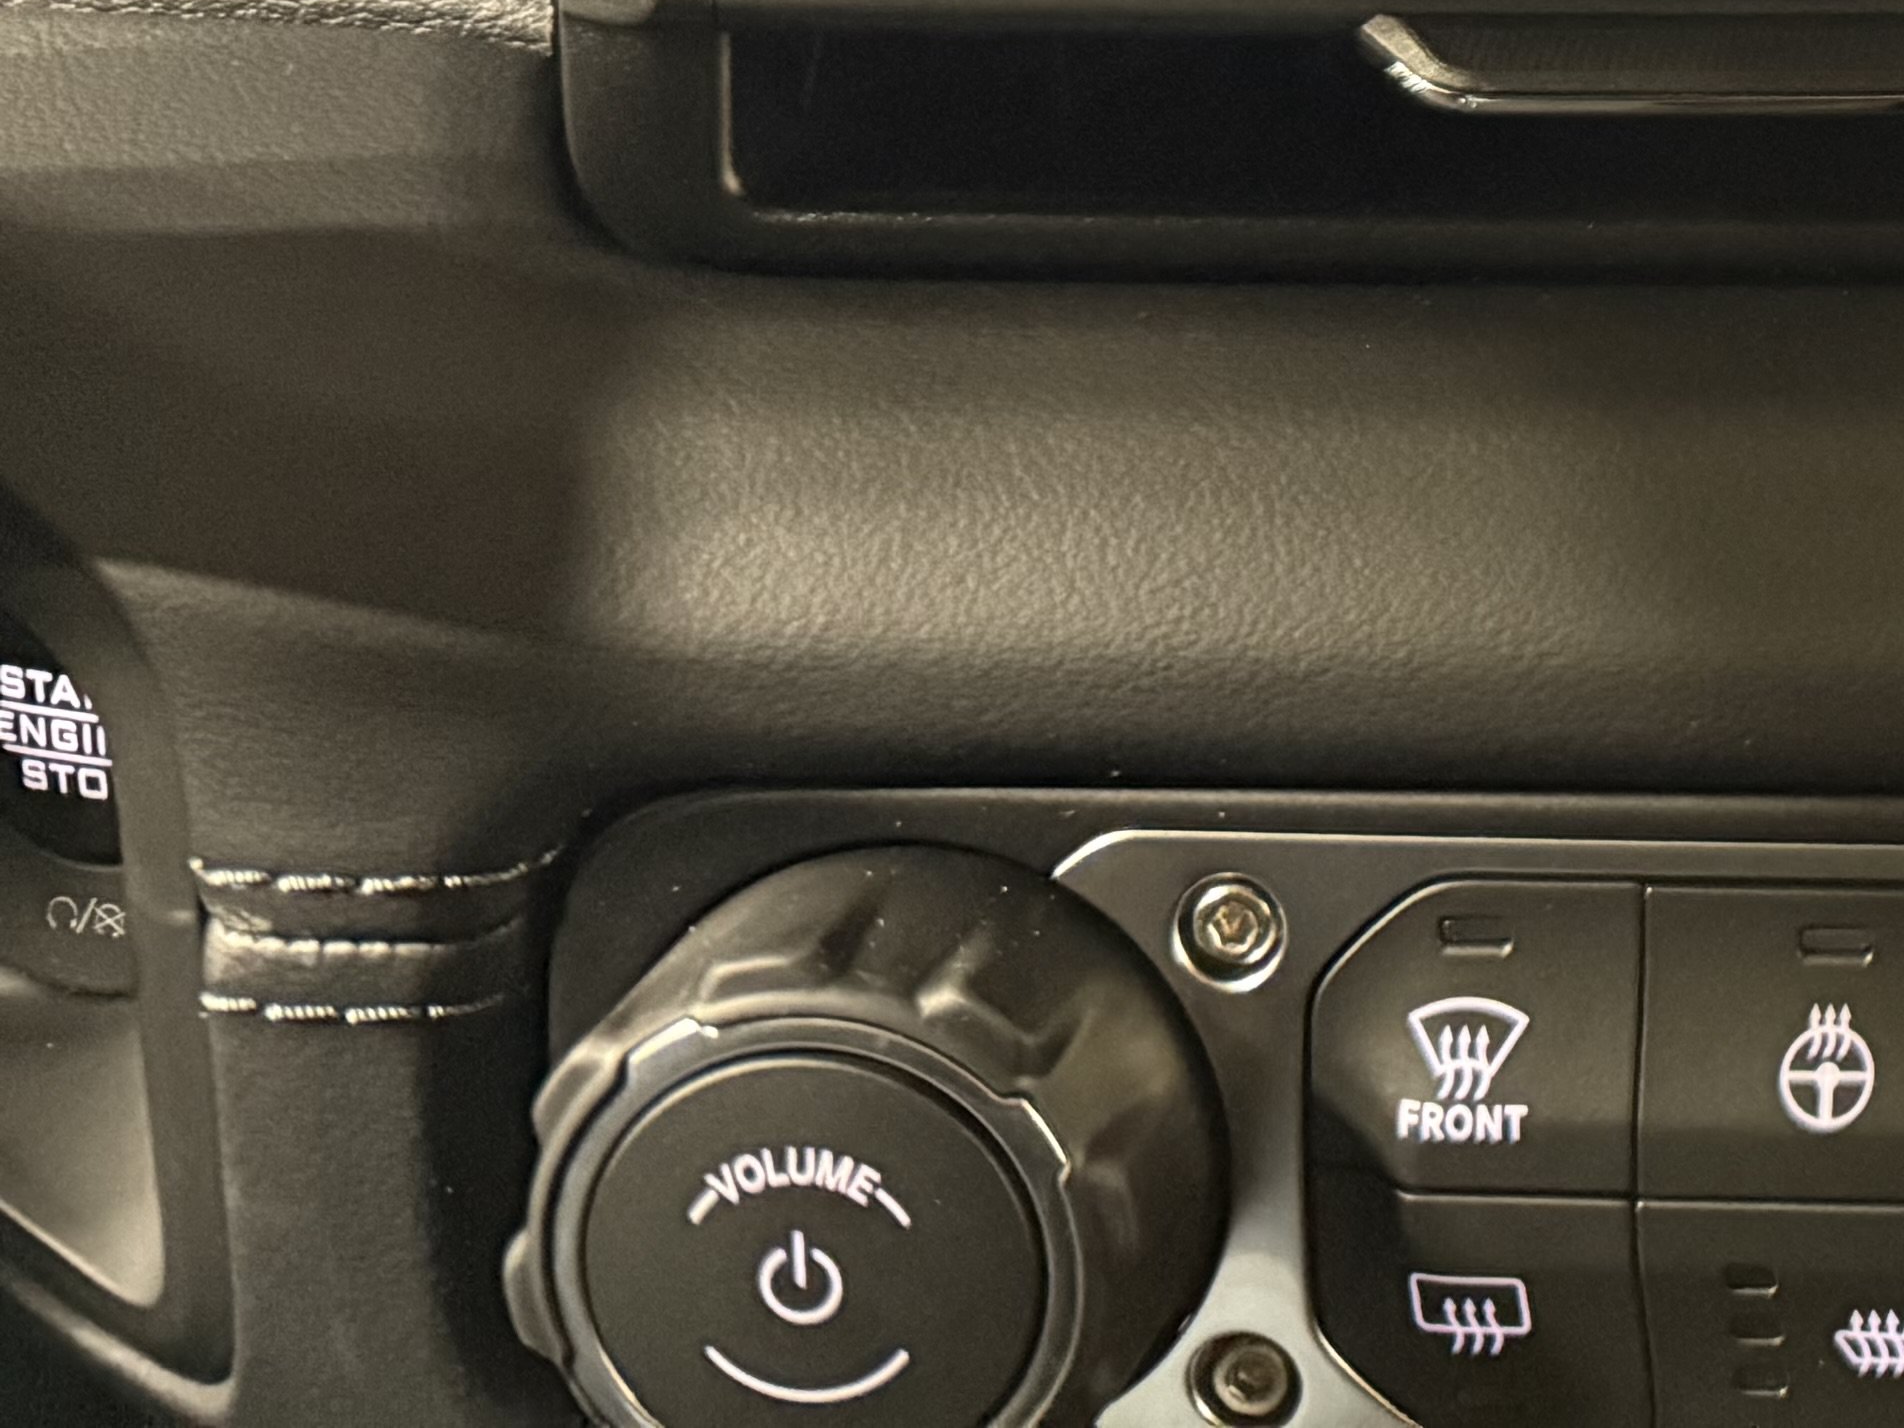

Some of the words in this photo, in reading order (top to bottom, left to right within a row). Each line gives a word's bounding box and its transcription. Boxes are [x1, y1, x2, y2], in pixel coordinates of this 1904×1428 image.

[0, 663, 93, 710] STA
[1398, 1098, 1529, 1143] FRONT
[703, 1145, 882, 1207] VOLUME
